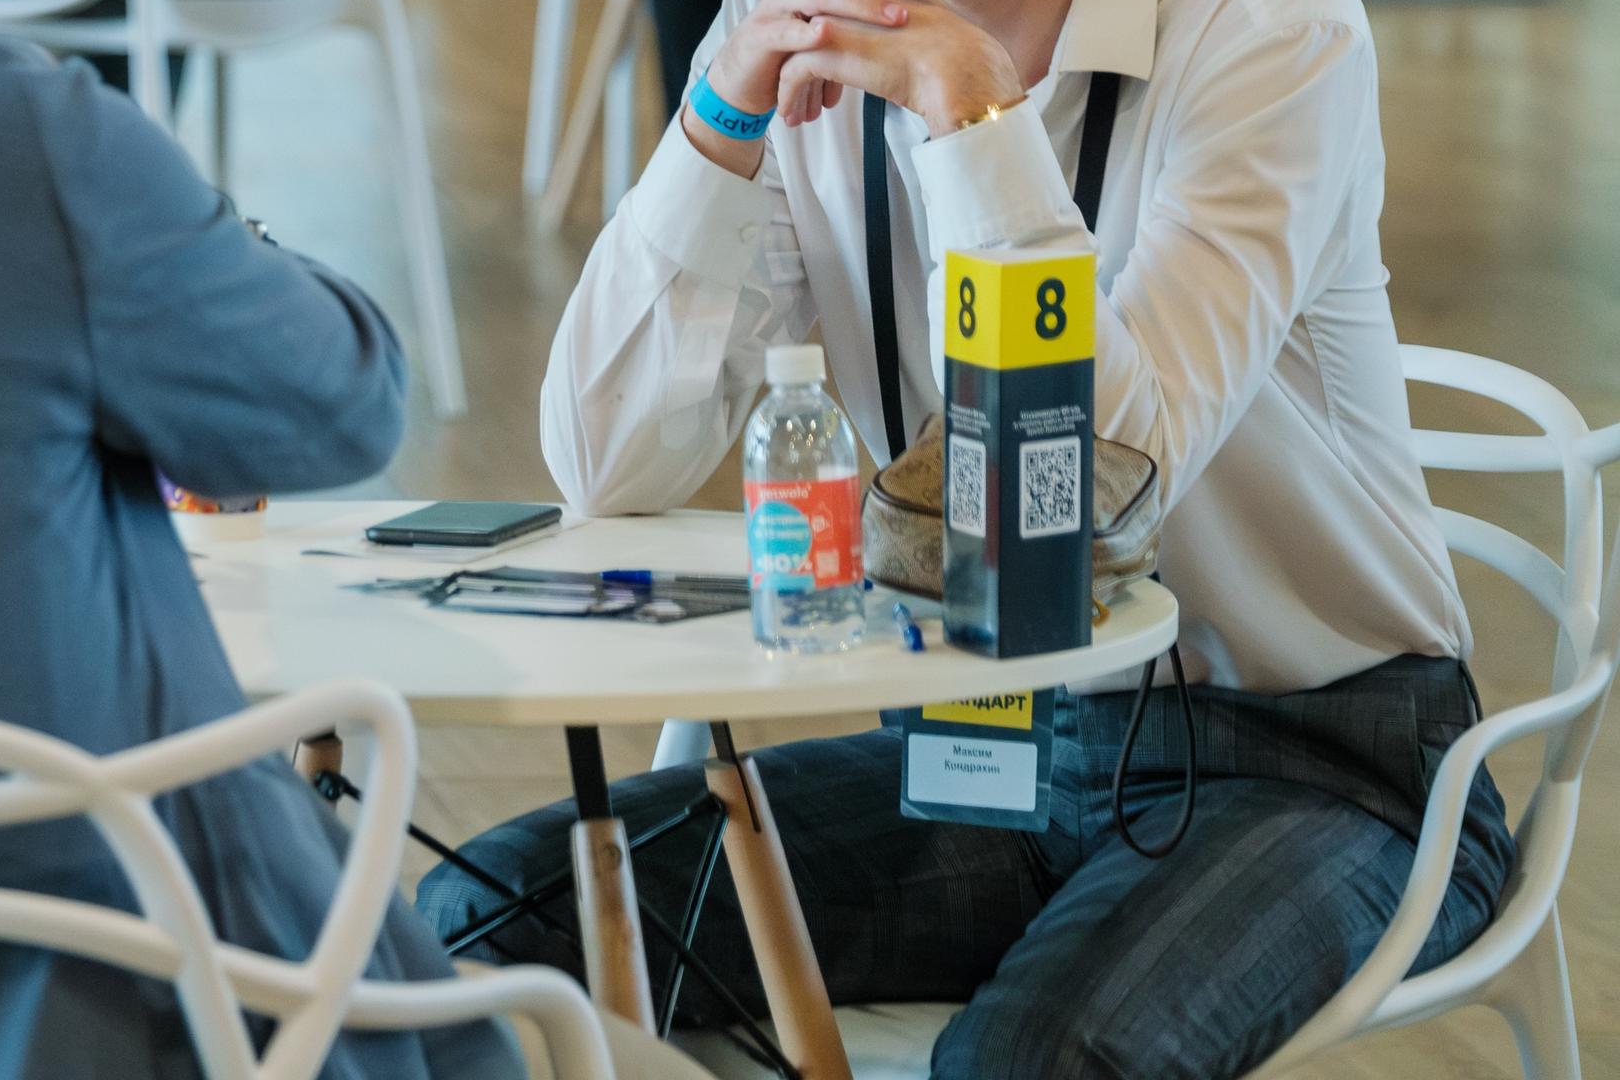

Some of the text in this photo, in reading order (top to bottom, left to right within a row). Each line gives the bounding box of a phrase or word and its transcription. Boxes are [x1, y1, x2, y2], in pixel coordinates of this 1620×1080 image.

[958, 276, 977, 339] 8
[1035, 277, 1068, 340] 8
[951, 694, 1027, 712] ДАРТ
[952, 744, 993, 759] Максим
